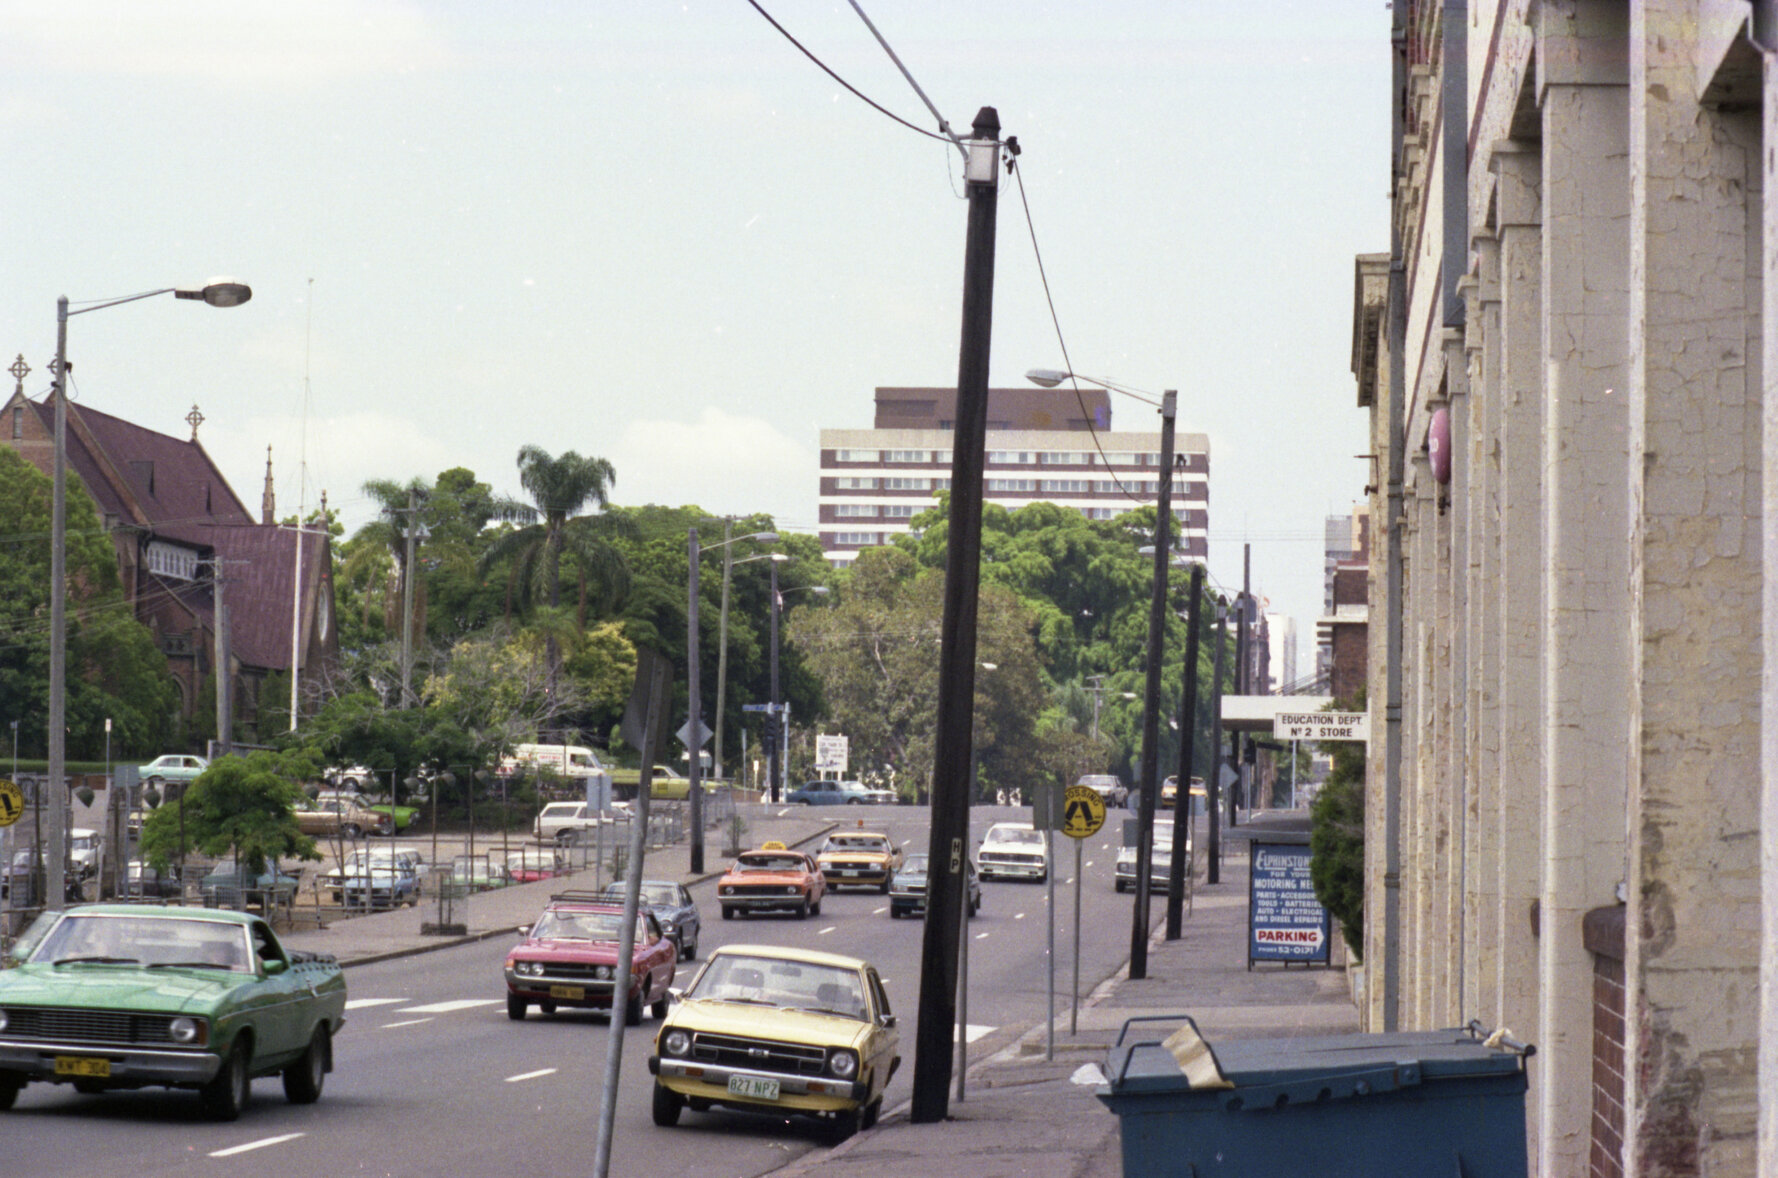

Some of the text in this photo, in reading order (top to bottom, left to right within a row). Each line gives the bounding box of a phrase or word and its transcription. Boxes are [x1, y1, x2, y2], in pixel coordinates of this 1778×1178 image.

[1282, 715, 1334, 725] EDUCATION
[1305, 727, 1313, 737] 2
[1320, 728, 1353, 737] STORE
[1064, 788, 1100, 807] OSSING
[1270, 871, 1286, 879] FOR
[1254, 878, 1297, 889] MOTORING
[1257, 899, 1278, 907] TOOLS
[1257, 907, 1324, 916] AUTO ELECTRICAL
[1294, 916, 1324, 924] REPAIRS
[1258, 930, 1318, 942] PARKING
[730, 1078, 751, 1092] 827
